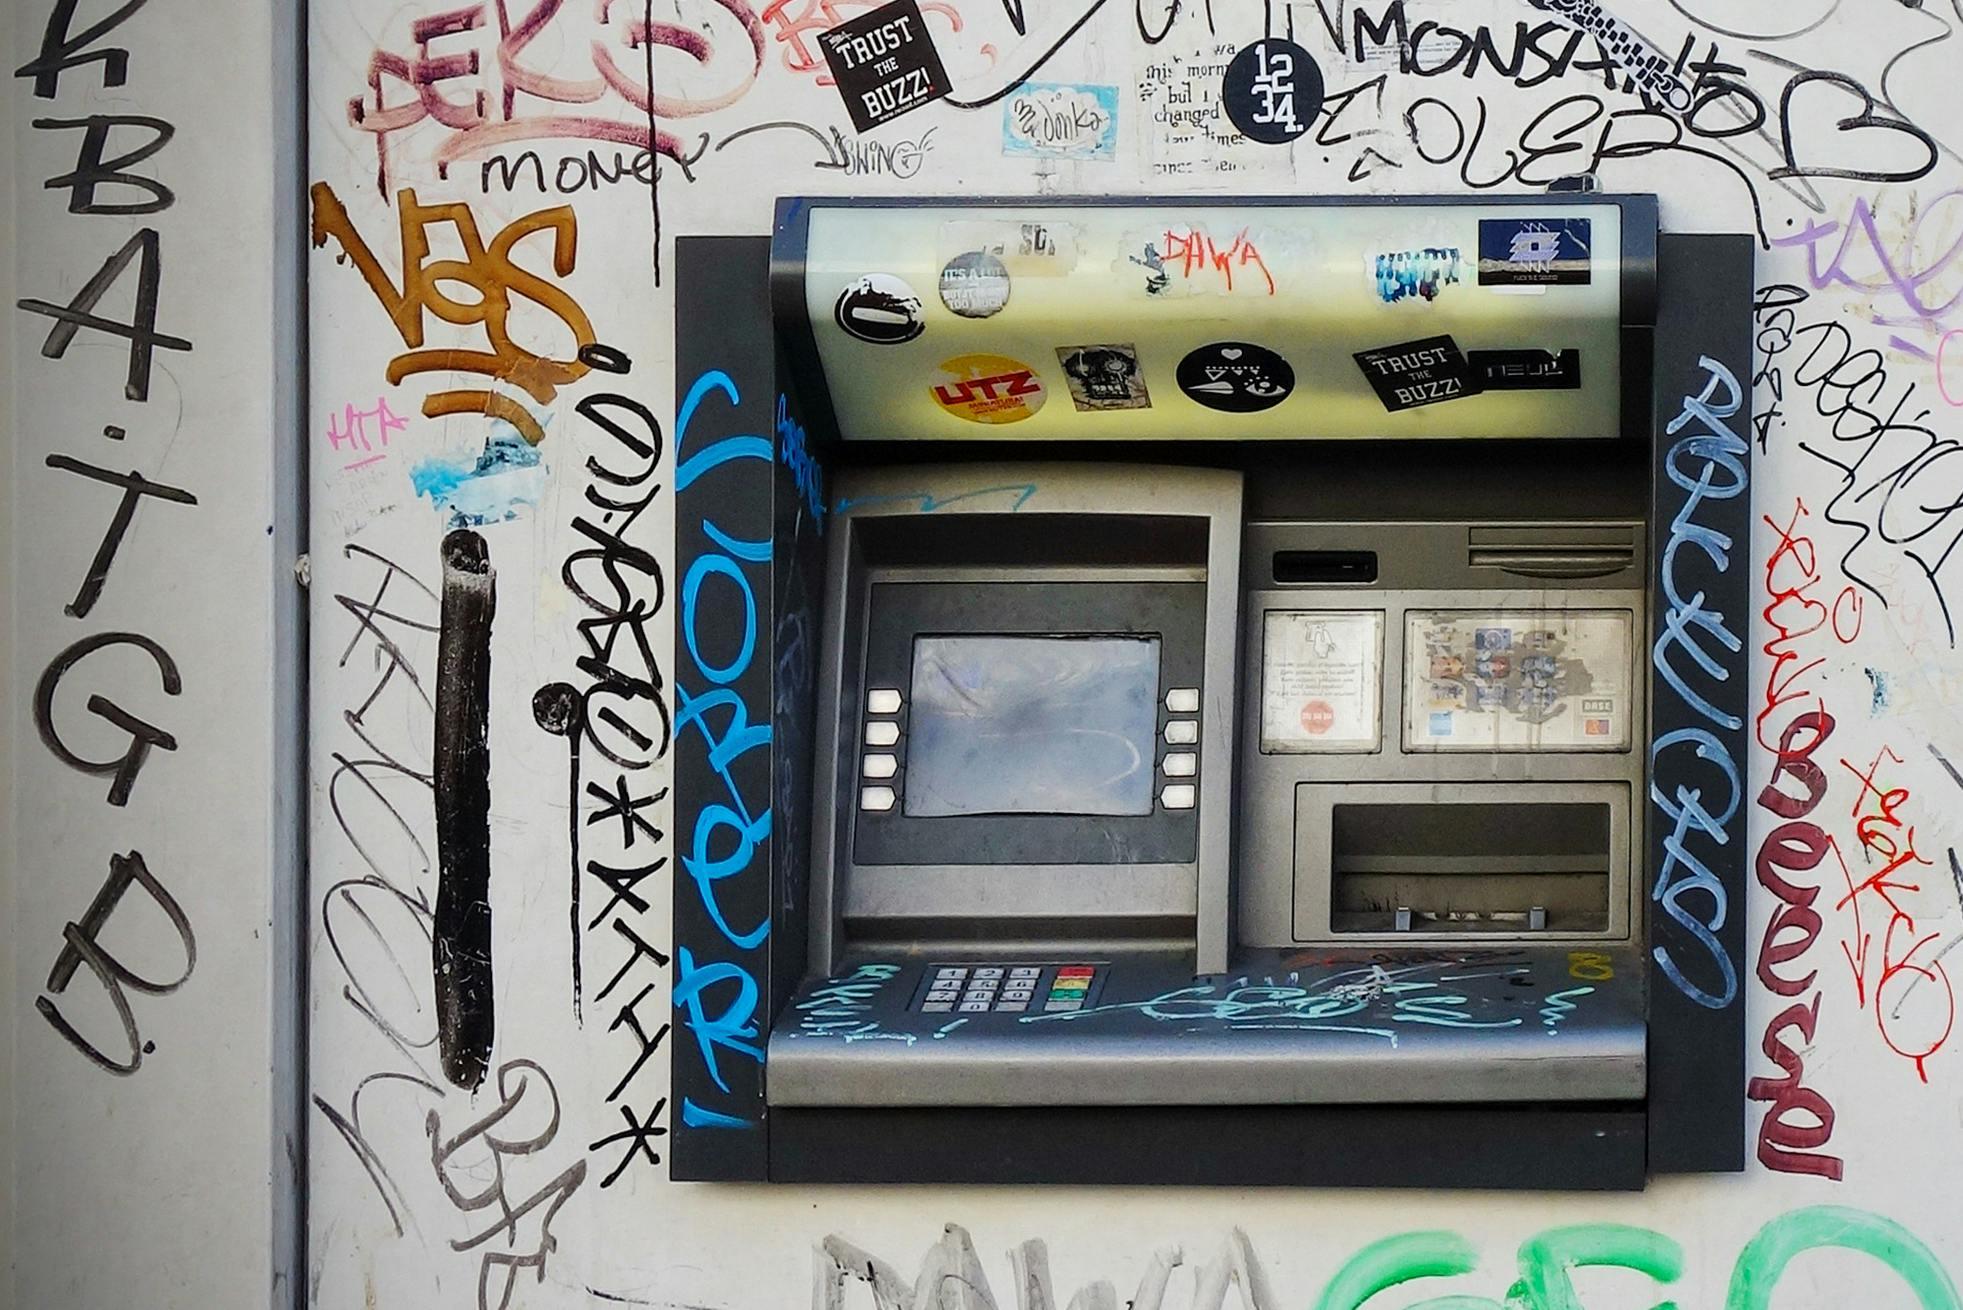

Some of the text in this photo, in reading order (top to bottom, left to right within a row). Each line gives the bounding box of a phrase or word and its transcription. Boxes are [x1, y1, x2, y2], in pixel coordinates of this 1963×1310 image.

[834, 15, 914, 69] TRUST
[873, 56, 900, 77] THE
[860, 66, 935, 119] BUZZ!
[1154, 102, 1221, 128] changed
[1371, 347, 1449, 376] TRUST
[1408, 370, 1433, 381] THE
[933, 370, 1041, 406] UTZ
[1394, 377, 1463, 405] BUZZ!
